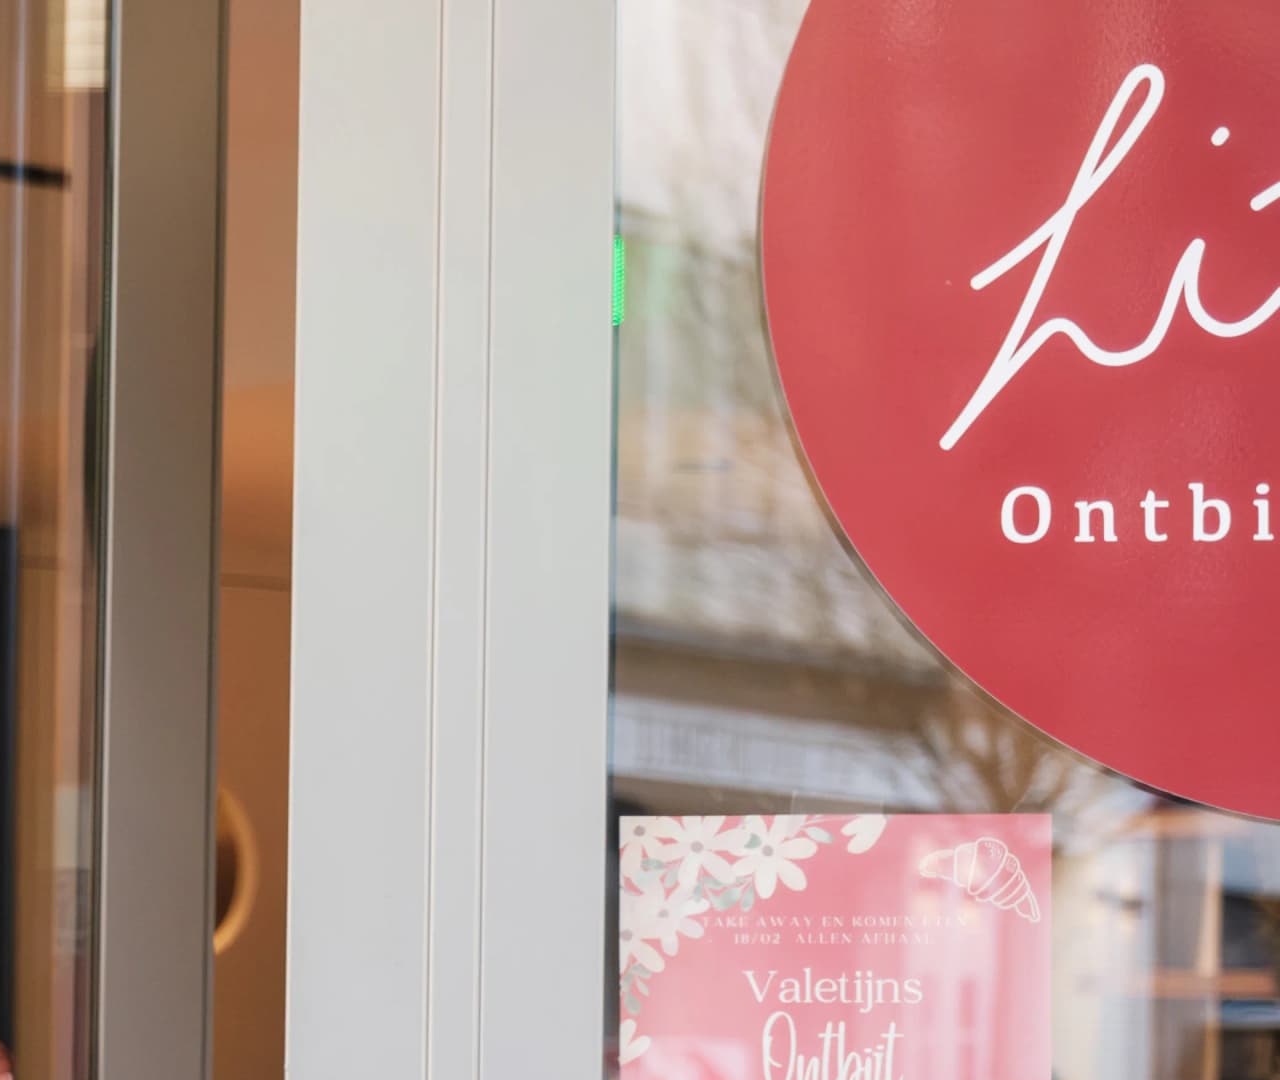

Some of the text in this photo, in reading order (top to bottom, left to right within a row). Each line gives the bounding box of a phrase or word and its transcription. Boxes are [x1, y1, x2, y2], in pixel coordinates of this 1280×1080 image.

[939, 63, 1280, 450] Li
[1000, 482, 1275, 544] Ontbi
[702, 915, 747, 928] TAKE
[756, 915, 813, 928] AWAY
[821, 915, 844, 928] EN
[742, 967, 924, 1014] Valetijns
